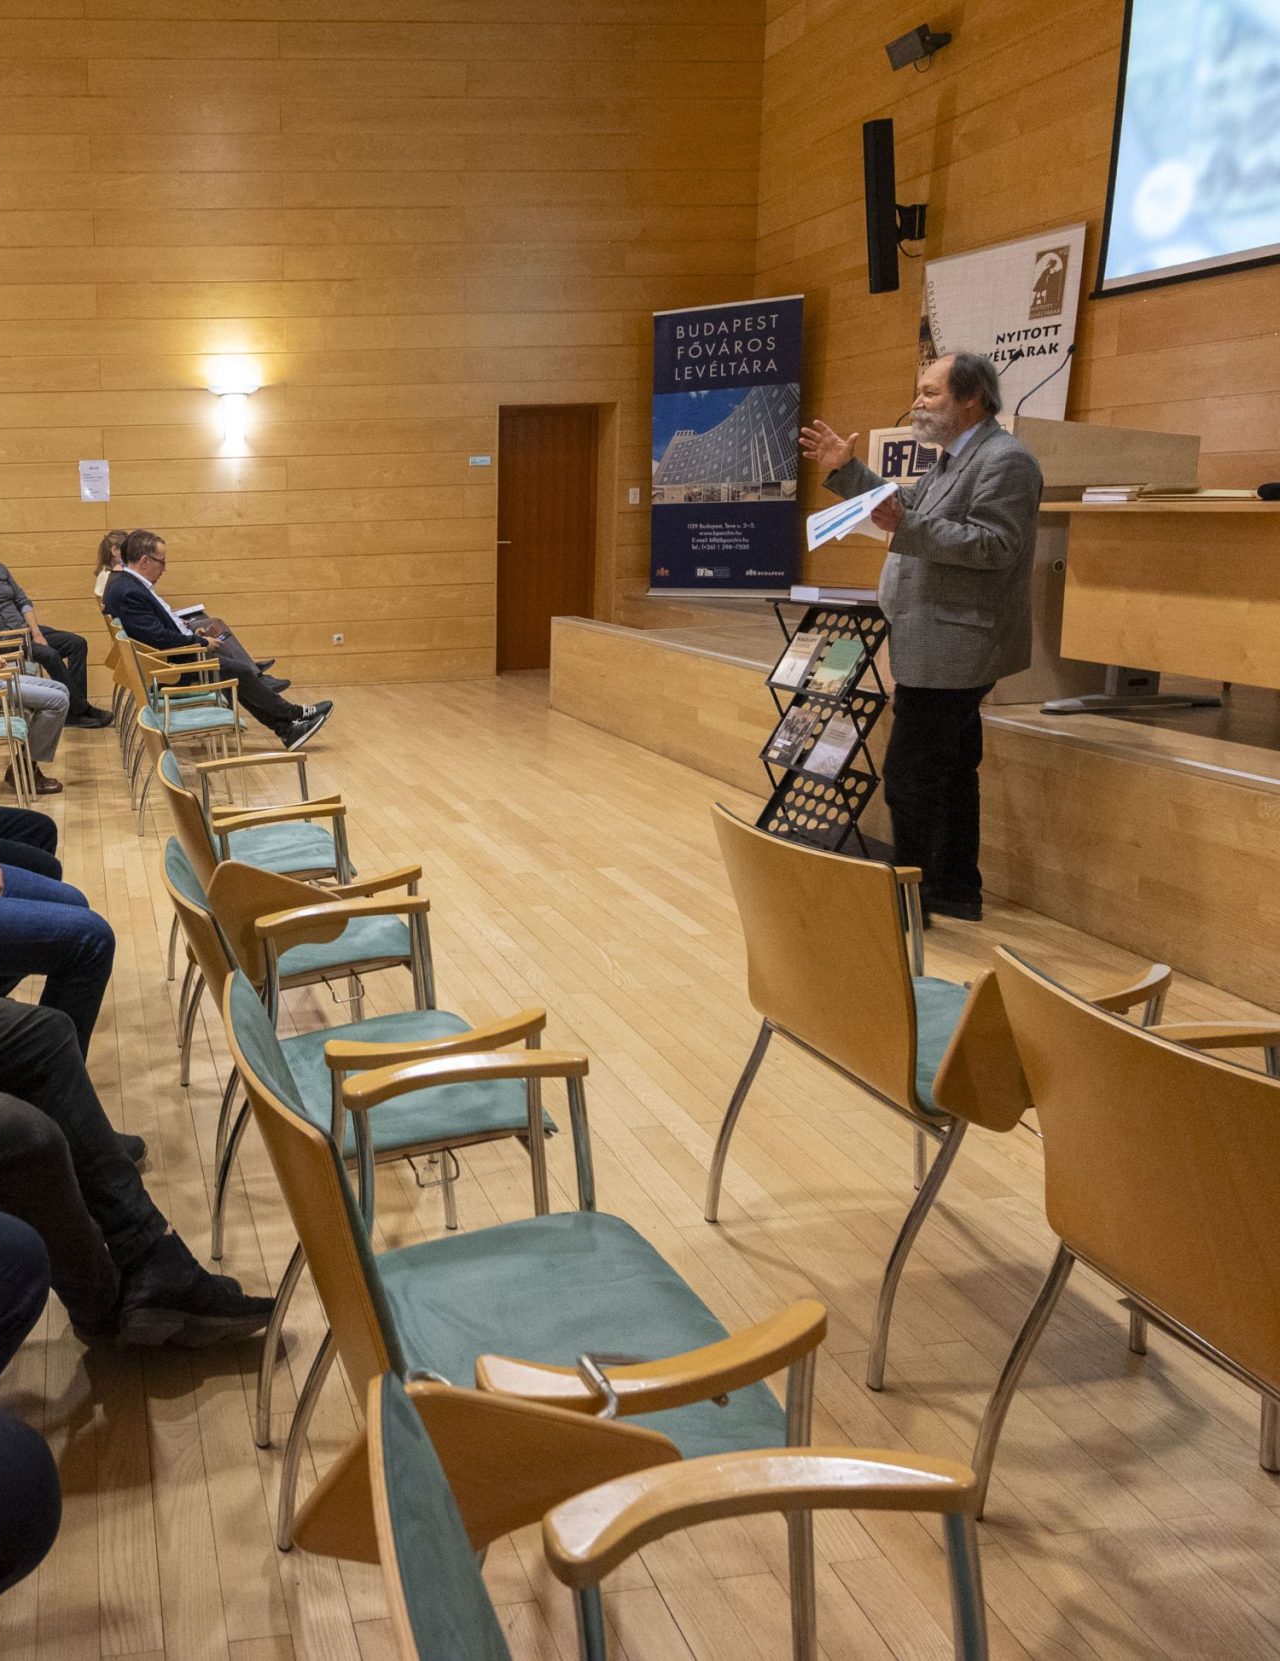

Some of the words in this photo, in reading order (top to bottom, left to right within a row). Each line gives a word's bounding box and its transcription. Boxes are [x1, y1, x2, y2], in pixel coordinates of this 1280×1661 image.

[676, 314, 779, 339] BUDAPEST
[995, 323, 1062, 345] NYITOTT
[677, 337, 776, 360] FŐVÁROS
[675, 357, 778, 381] LEVÉLTÁRA
